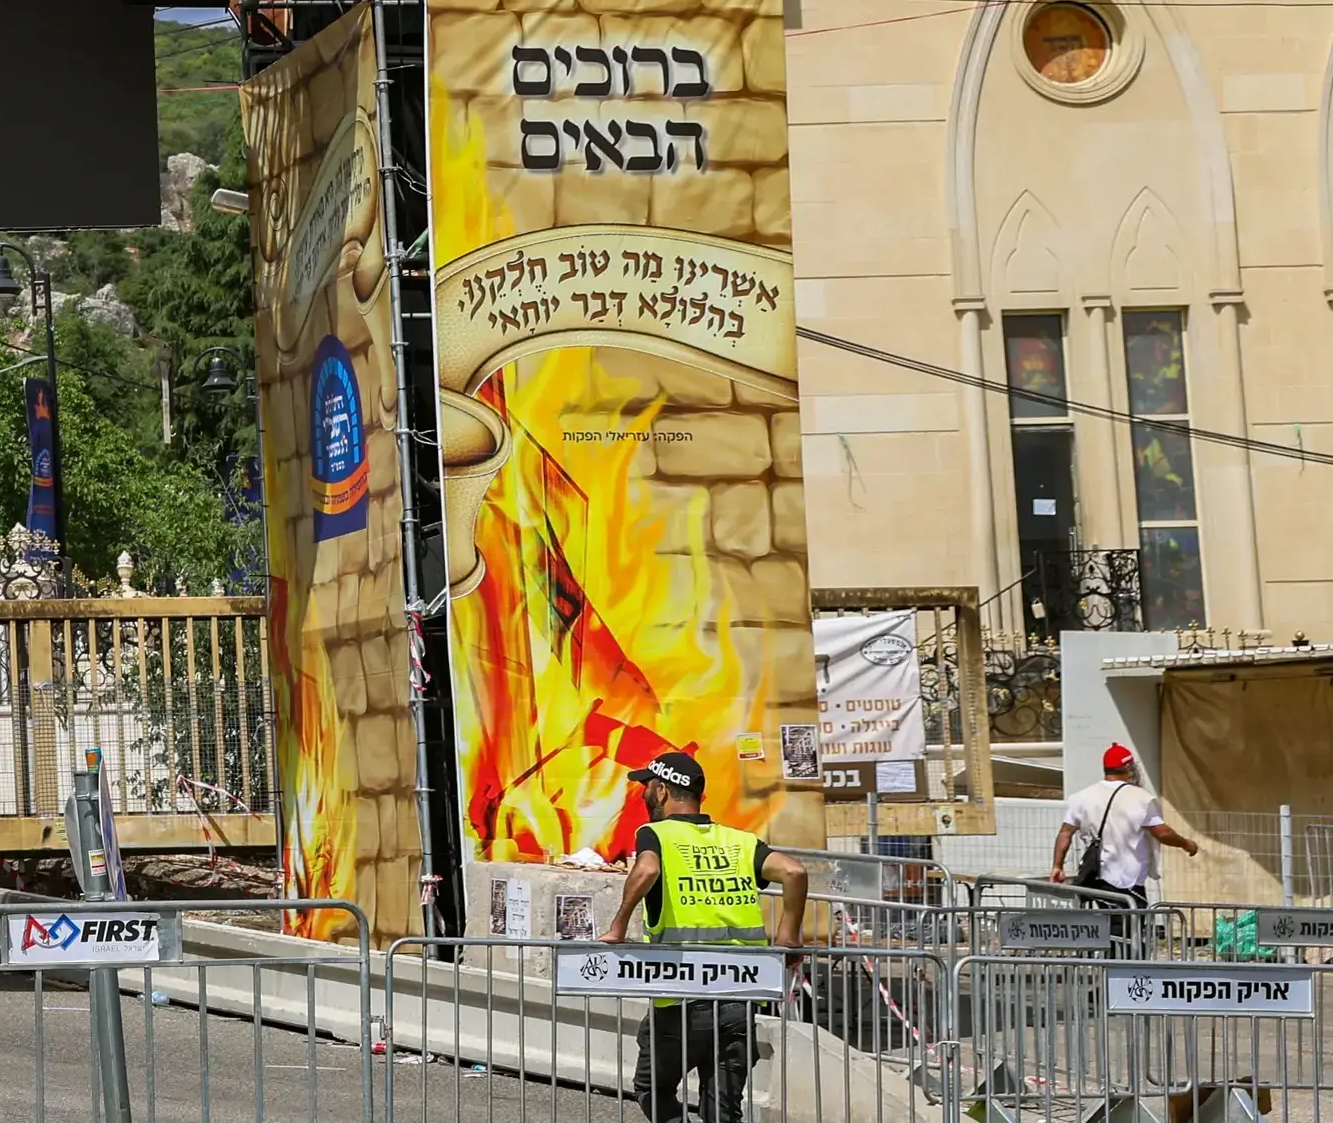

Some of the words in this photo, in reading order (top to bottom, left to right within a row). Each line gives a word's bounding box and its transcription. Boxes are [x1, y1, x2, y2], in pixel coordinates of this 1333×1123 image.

[511, 44, 710, 97] ברוכים
[520, 118, 704, 172] הבאים
[562, 430, 603, 443] הפקות
[605, 429, 650, 443] עזריאלי
[653, 430, 693, 443] הפקה:
[846, 699, 902, 712] טוסטים
[850, 719, 901, 733] בייגלה
[853, 741, 893, 755] עוגות
[648, 760, 691, 787] adidas
[693, 854, 731, 870] עוז
[678, 876, 754, 893] אבטחה
[80, 920, 157, 943] FIRST
[1029, 925, 1069, 940] הפקות
[1070, 925, 1100, 939] אריק
[92, 945, 121, 953] ISRAEL
[617, 960, 695, 984] הפקות
[702, 964, 759, 985] אריק
[1161, 980, 1231, 1002] הפקות
[1237, 981, 1290, 1003] אריק
